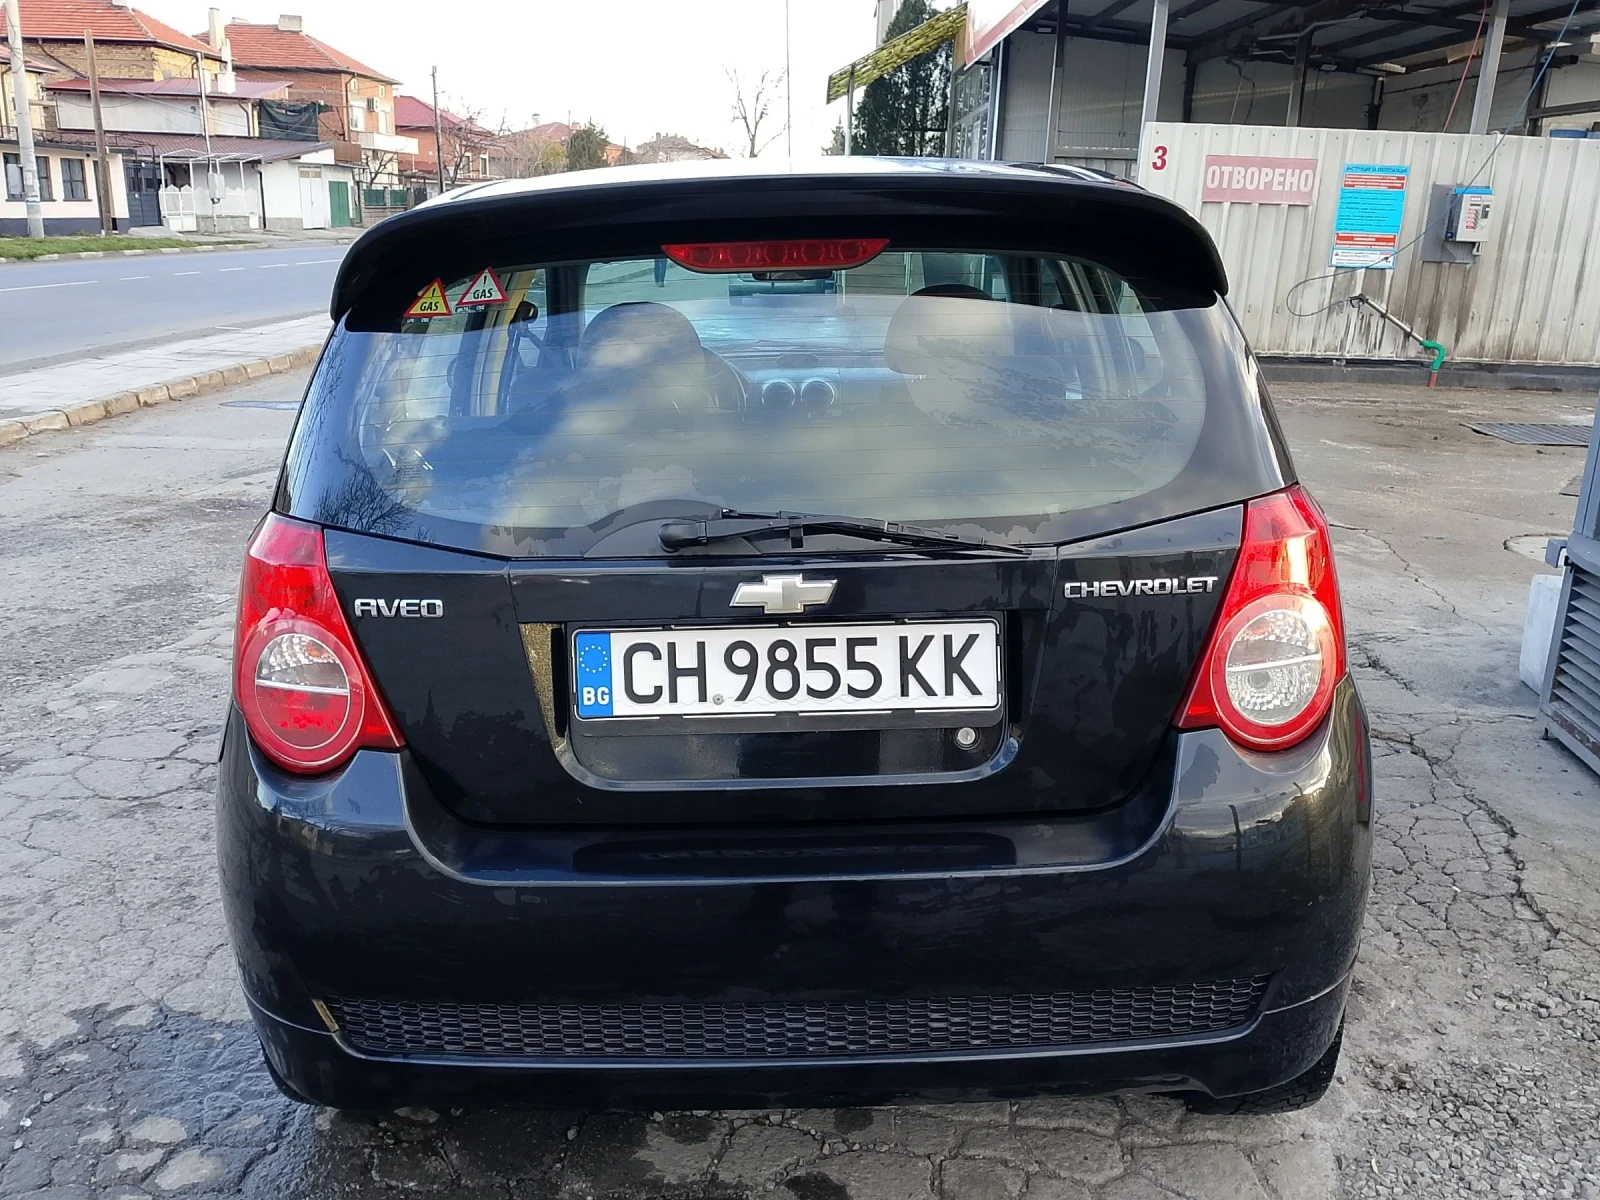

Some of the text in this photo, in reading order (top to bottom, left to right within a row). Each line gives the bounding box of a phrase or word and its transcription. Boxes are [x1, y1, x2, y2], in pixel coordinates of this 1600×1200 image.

[1151, 145, 1168, 171] 3
[1206, 165, 1314, 193] ОТВОРЕНО
[473, 288, 493, 300] GAS
[419, 301, 439, 312] GAS
[1063, 575, 1219, 599] CHEVROLET
[353, 598, 445, 618] AVEO
[623, 633, 983, 705] CH 9855 KK
[582, 685, 610, 707] BG
